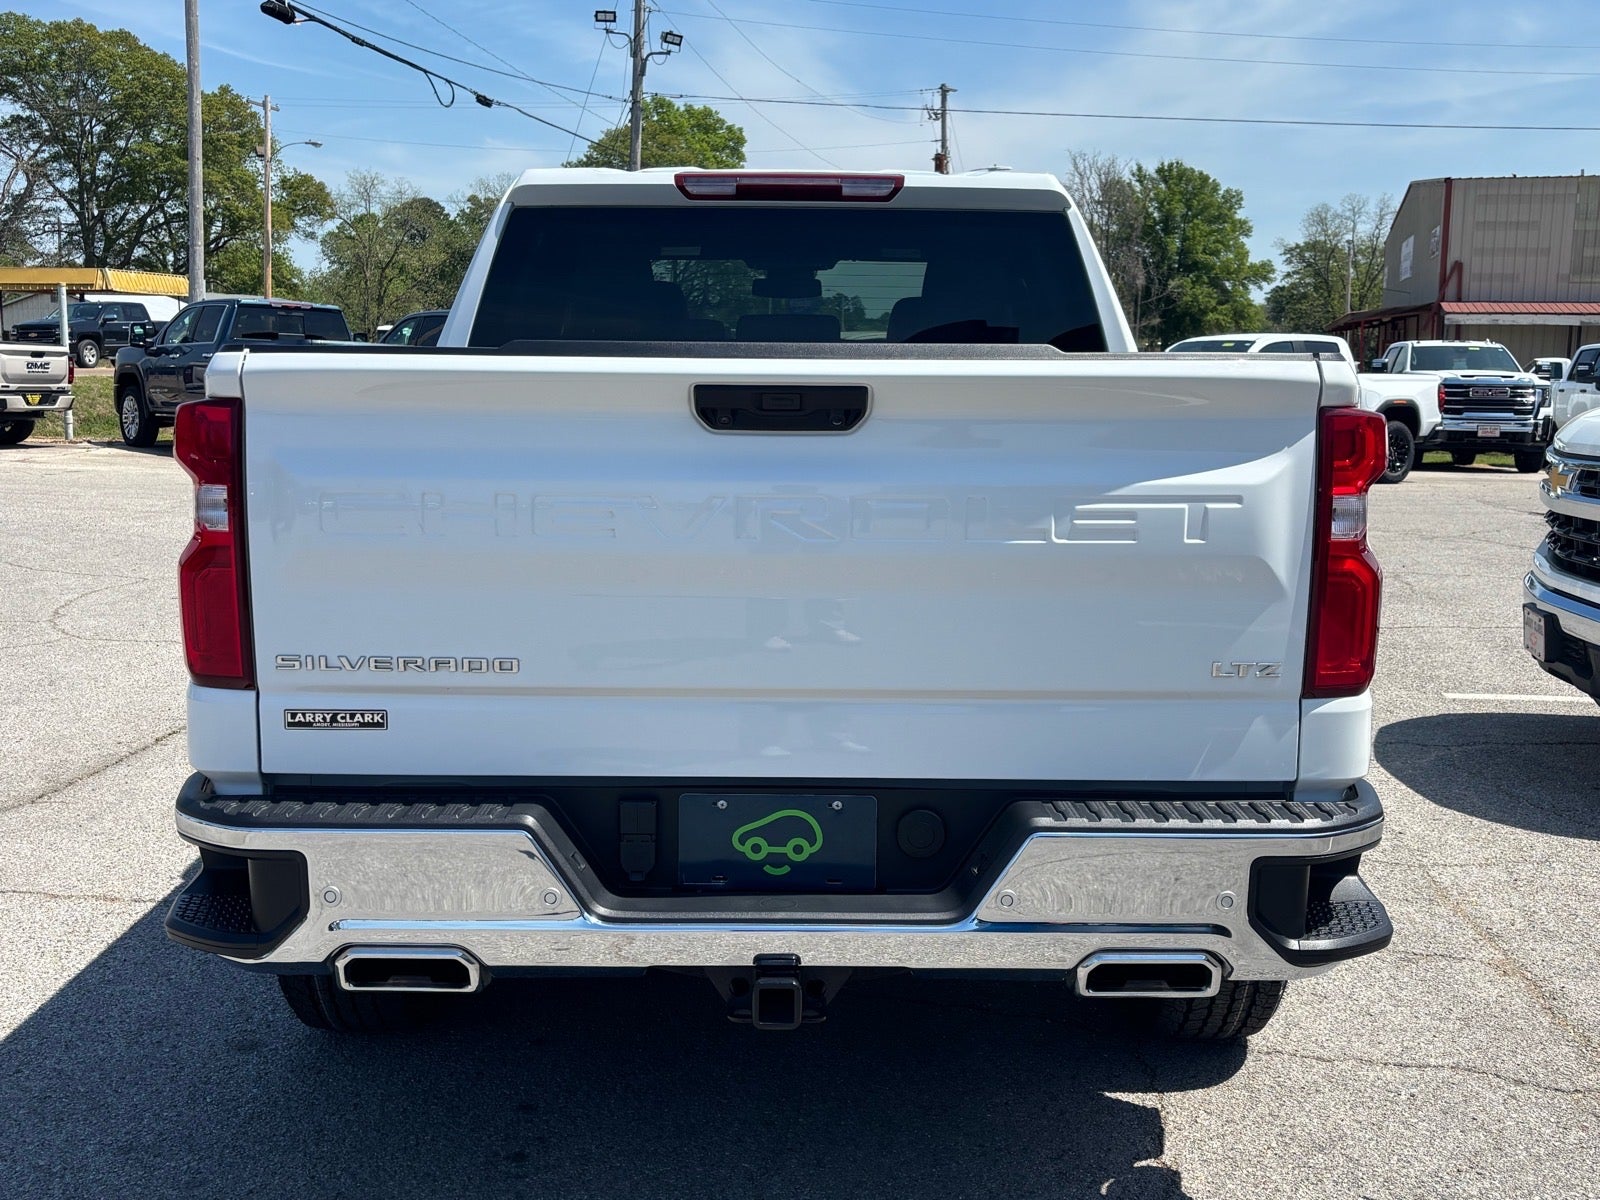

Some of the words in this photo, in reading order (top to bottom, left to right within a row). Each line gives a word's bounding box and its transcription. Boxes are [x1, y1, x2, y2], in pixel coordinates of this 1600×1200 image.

[319, 491, 1244, 544] CHEVROLET
[275, 654, 520, 674] SILVERADO
[1211, 661, 1282, 678] LTZ
[287, 712, 333, 723] LARRY
[336, 713, 384, 723] CLARK
